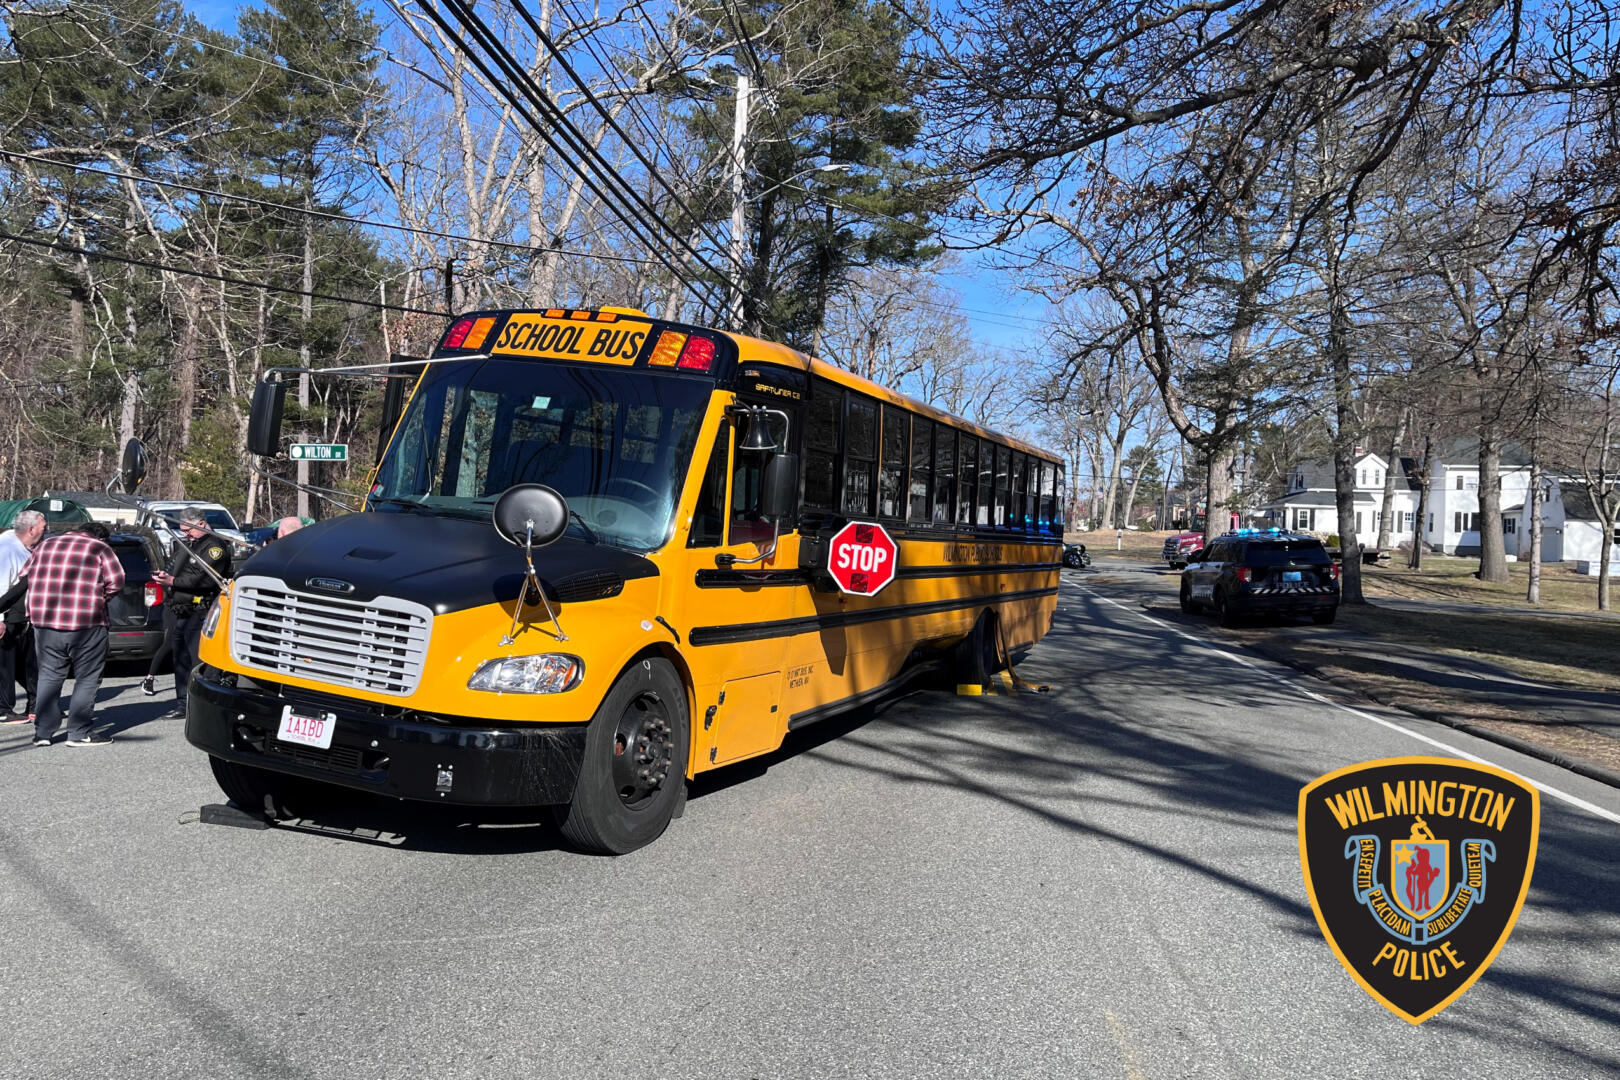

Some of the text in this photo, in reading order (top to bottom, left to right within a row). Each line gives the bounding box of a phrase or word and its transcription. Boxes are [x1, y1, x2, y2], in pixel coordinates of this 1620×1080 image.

[496, 321, 645, 360] SCHOOL BUS
[304, 446, 332, 458] WILTON
[837, 543, 887, 573] STOP
[1276, 581, 1310, 589] POLICE
[285, 716, 324, 738] 1A1BD
